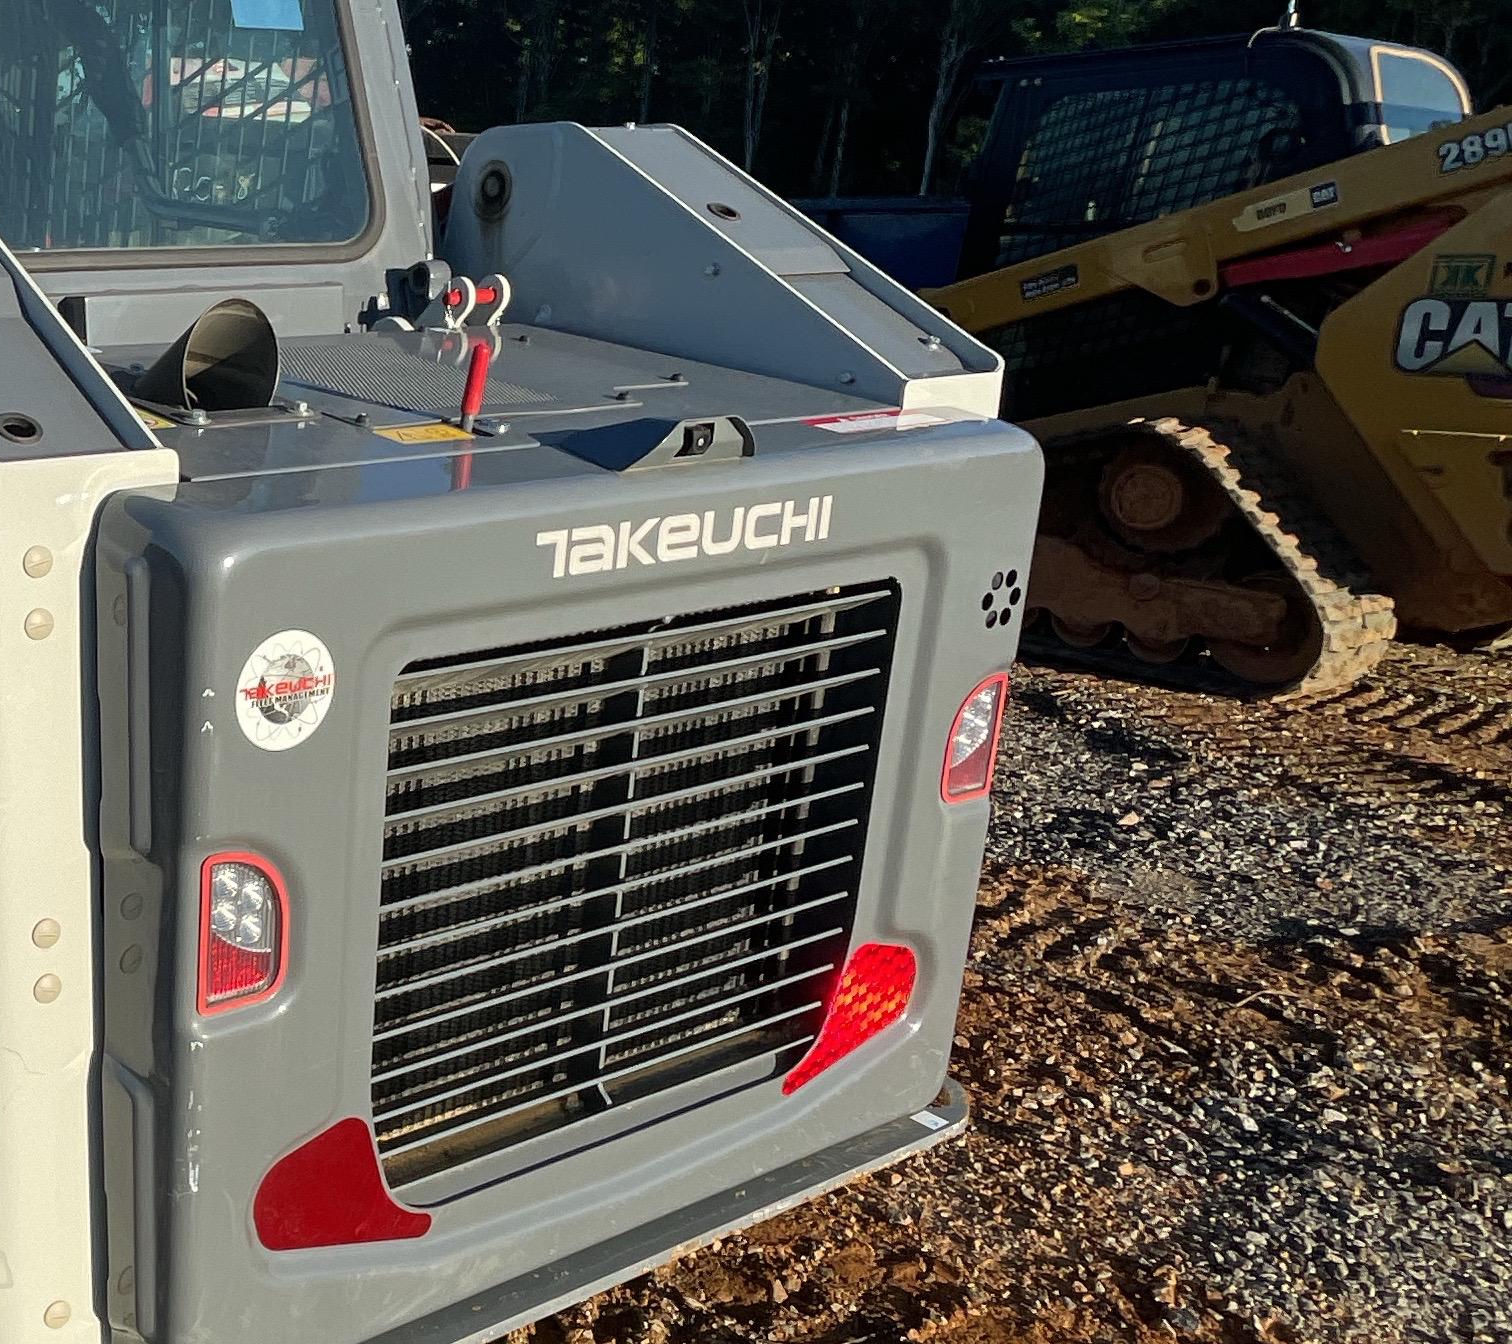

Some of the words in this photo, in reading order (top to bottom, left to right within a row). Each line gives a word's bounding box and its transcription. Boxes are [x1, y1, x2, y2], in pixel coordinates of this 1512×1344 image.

[1438, 123, 1512, 173] 289
[1395, 298, 1512, 372] CA
[536, 494, 834, 579] TAKEUCHI
[275, 686, 331, 703] MANAGEMENT
